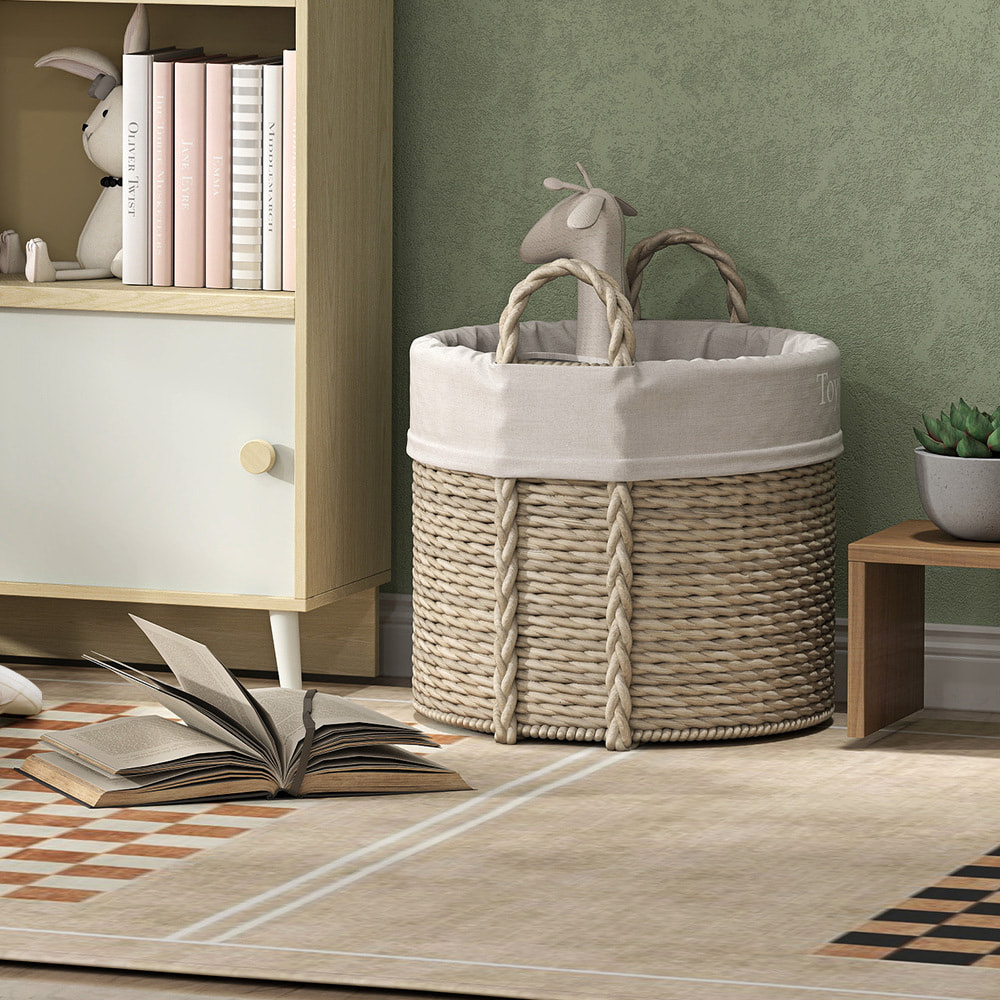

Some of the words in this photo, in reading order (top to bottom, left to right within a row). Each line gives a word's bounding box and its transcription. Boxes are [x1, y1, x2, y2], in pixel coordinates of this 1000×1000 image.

[128, 121, 139, 172] OLIVER
[181, 139, 194, 169] JANE
[128, 175, 139, 218] TWIST
[181, 175, 193, 210] EYRE
[213, 155, 224, 197] EMMA
[268, 121, 276, 232] MIDDLEMARCH
